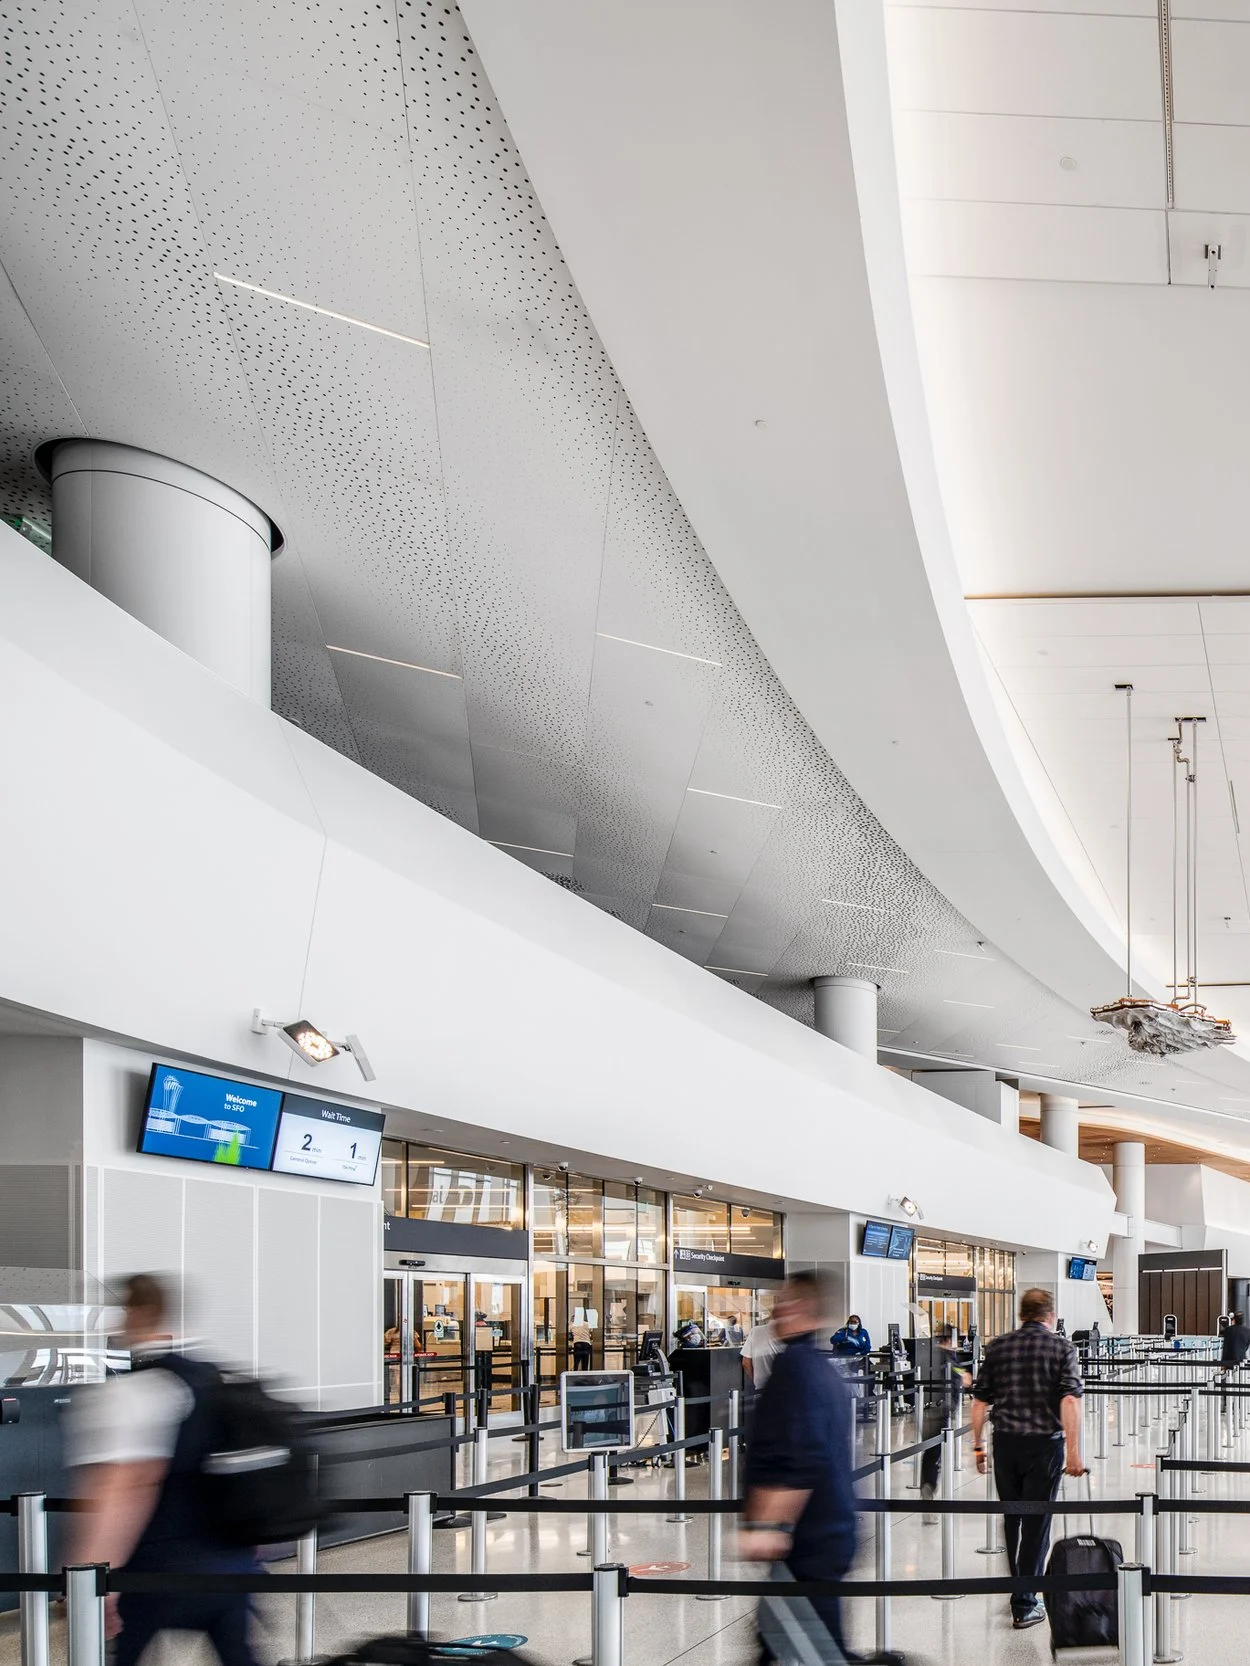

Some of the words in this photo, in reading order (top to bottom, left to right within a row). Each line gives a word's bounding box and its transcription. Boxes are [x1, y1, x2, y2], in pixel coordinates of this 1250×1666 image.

[226, 1093, 257, 1107] Welcome
[231, 1103, 245, 1113] SFO
[321, 1109, 336, 1120] Wait
[336, 1112, 351, 1123] Time
[301, 1133, 312, 1151] 2
[350, 1142, 357, 1159] 1
